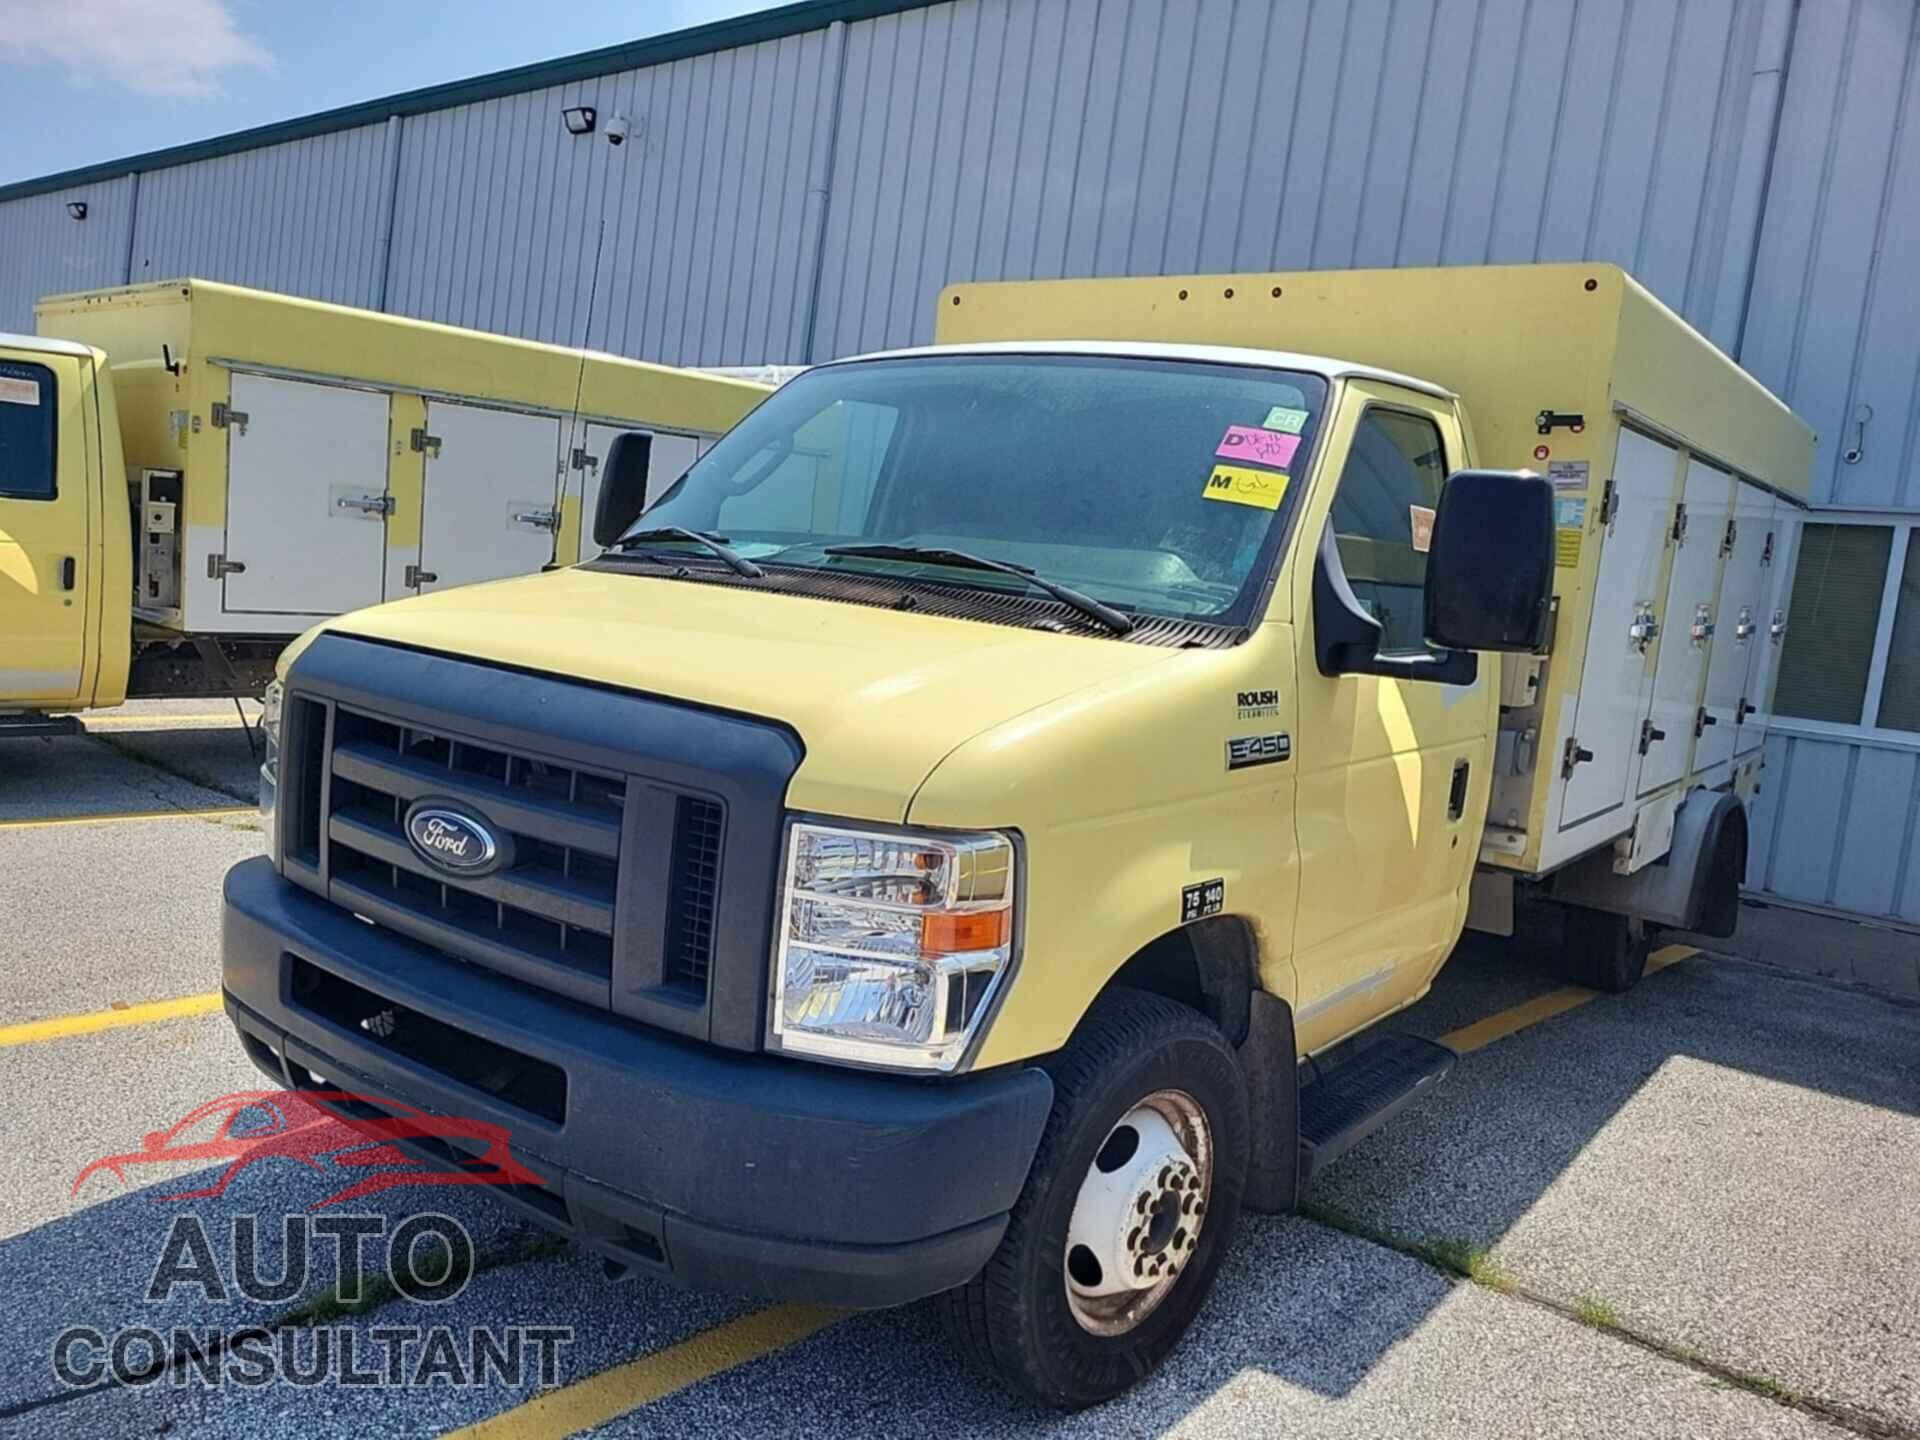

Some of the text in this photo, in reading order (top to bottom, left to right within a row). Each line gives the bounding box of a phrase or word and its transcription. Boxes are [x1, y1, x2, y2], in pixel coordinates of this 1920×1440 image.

[1224, 433, 1245, 446] D
[1210, 474, 1232, 489] M
[1237, 690, 1279, 707] ROUSH
[422, 817, 469, 857] Ford
[1186, 890, 1200, 909] 75
